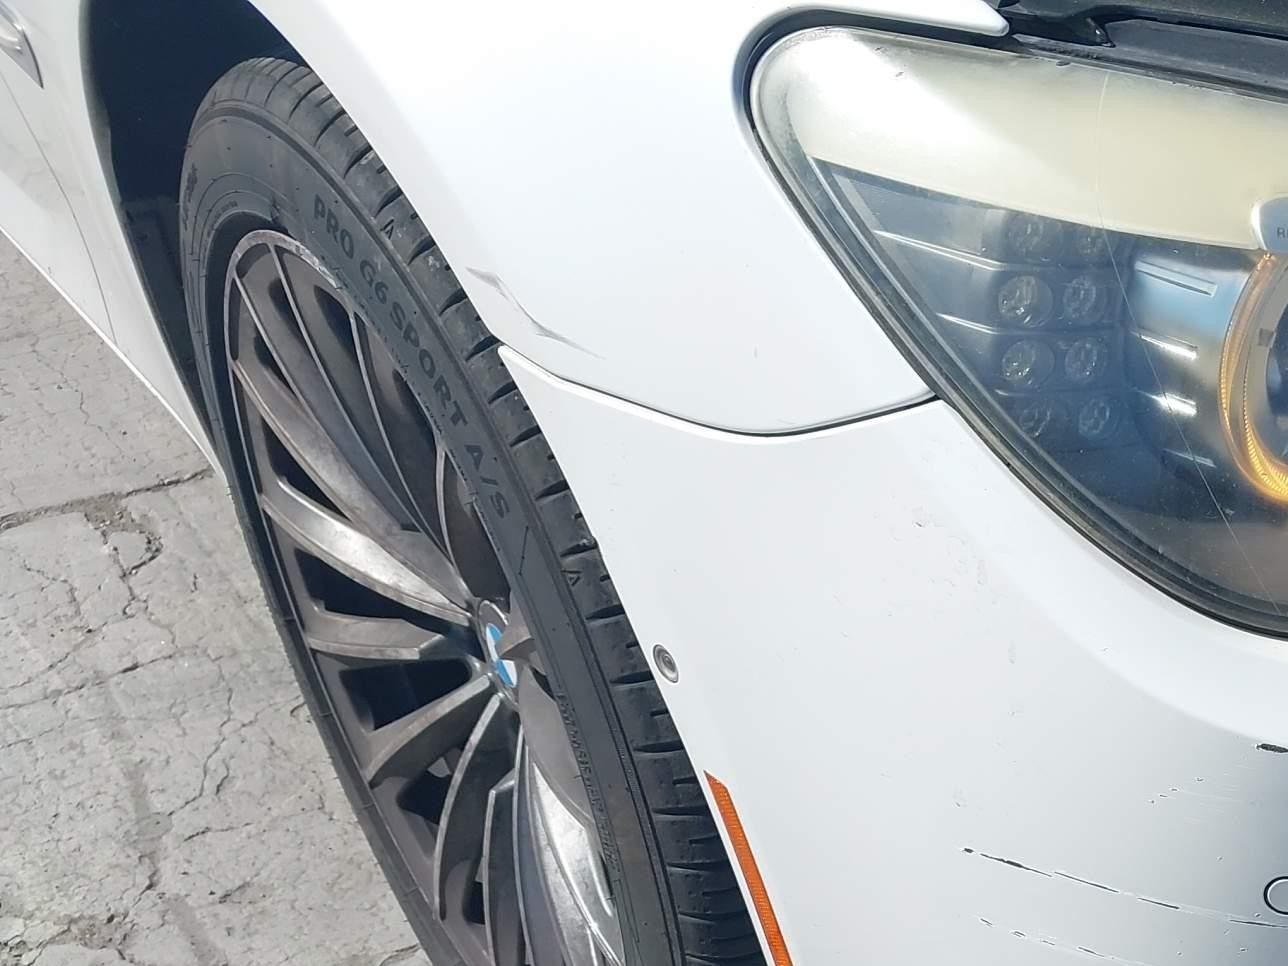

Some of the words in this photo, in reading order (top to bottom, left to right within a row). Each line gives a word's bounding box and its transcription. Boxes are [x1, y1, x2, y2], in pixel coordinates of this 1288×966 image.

[313, 195, 355, 260] PRO
[359, 259, 389, 305] G6
[390, 301, 467, 426] SPORT
[464, 445, 510, 518] A/S
